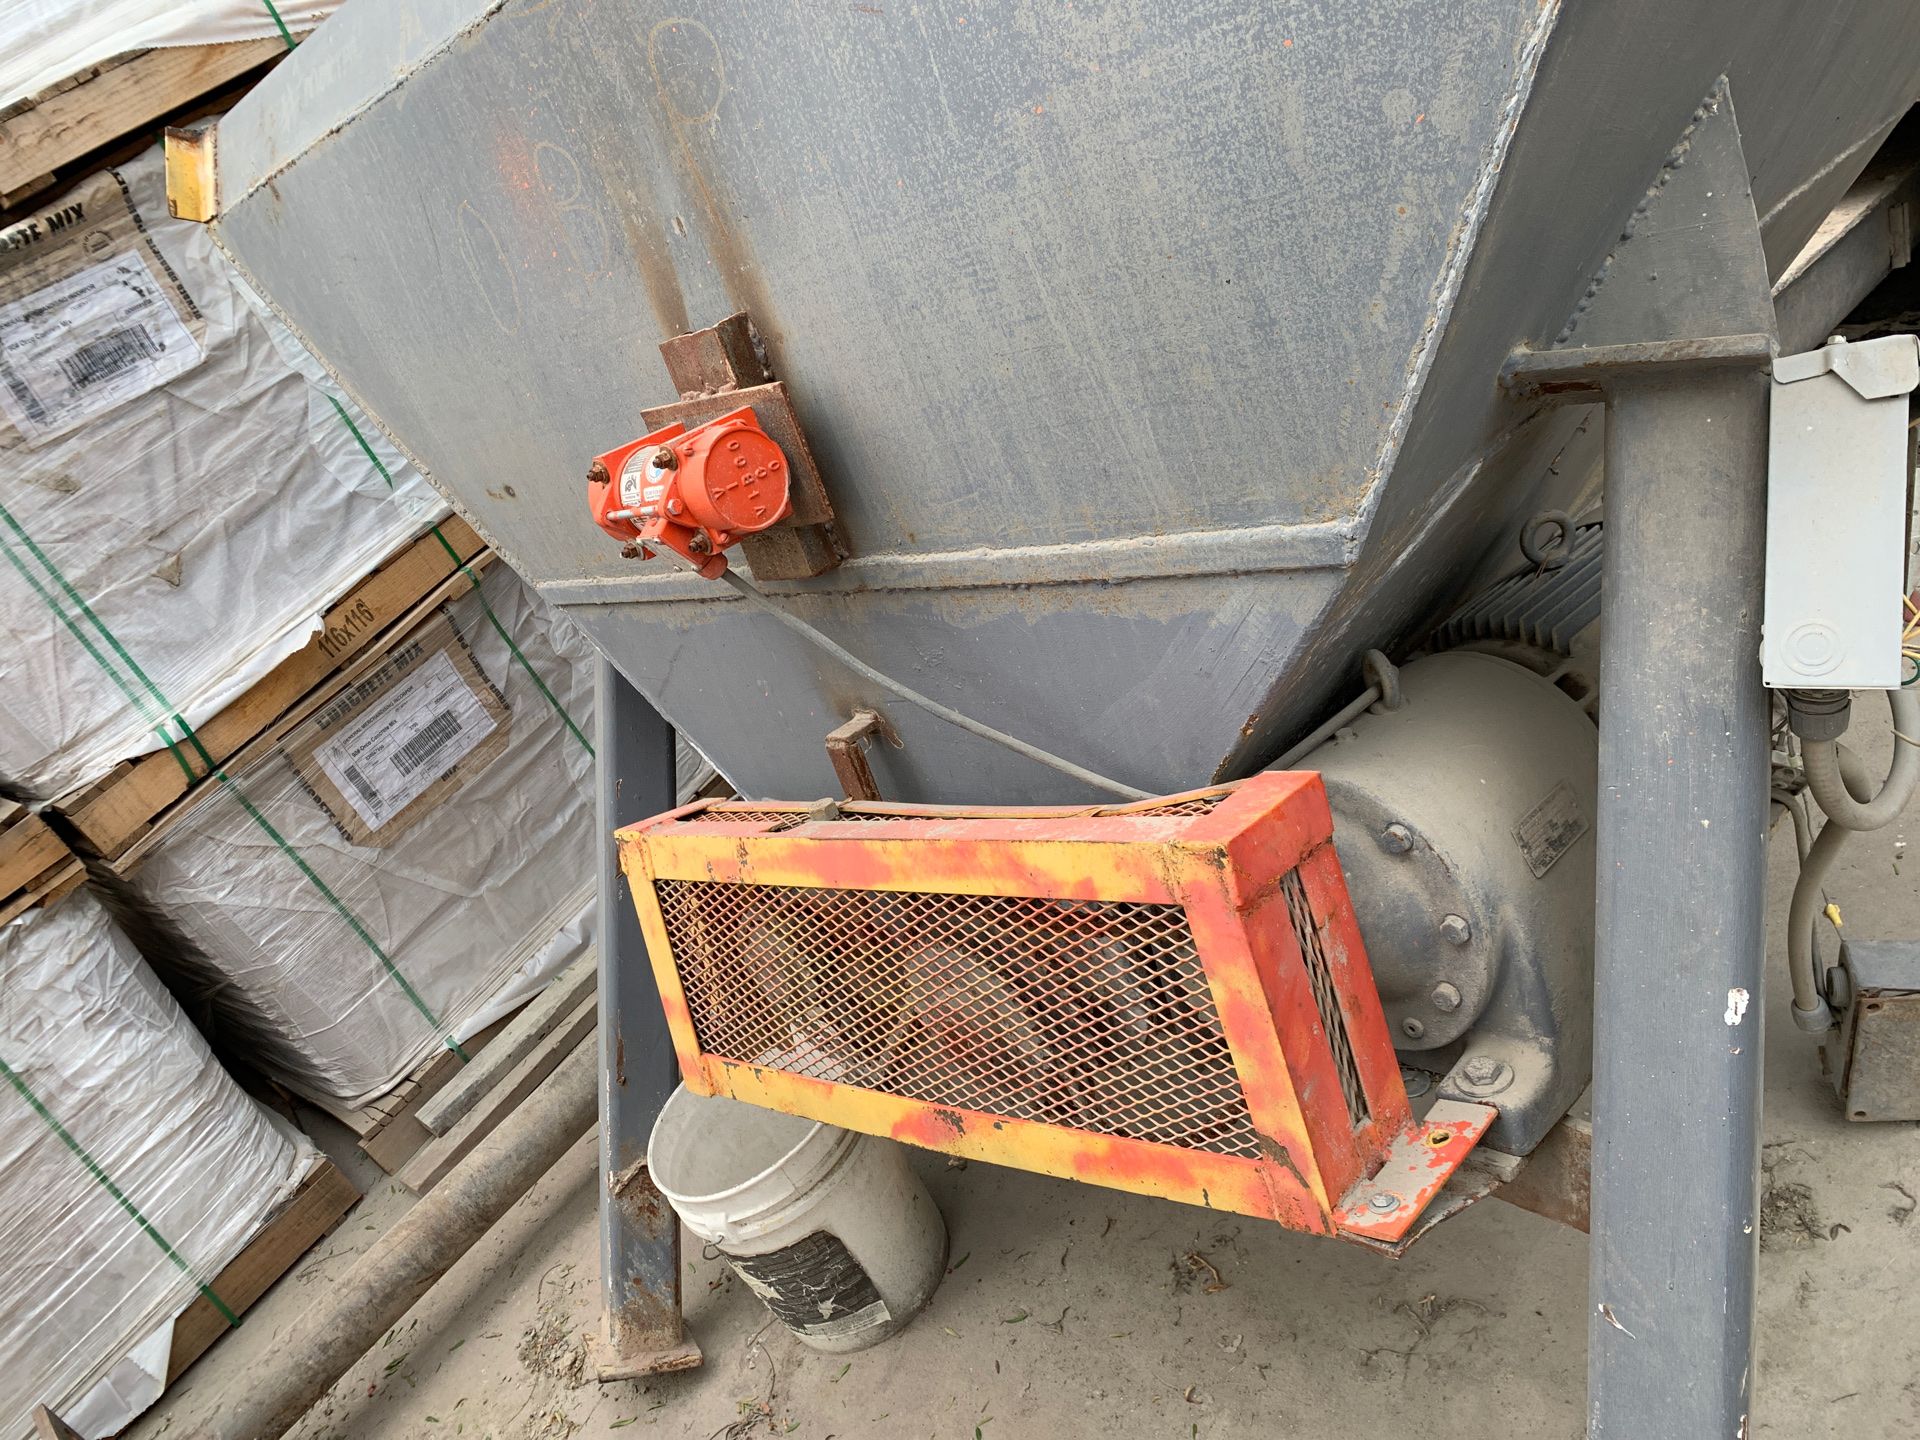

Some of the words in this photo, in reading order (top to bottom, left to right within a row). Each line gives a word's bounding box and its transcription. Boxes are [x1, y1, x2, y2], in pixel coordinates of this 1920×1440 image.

[45, 202, 86, 234] MIX
[713, 460, 780, 500] VIBCO
[318, 598, 375, 658] 116x116
[314, 664, 393, 731] CONCRETE
[392, 639, 425, 672] MIX
